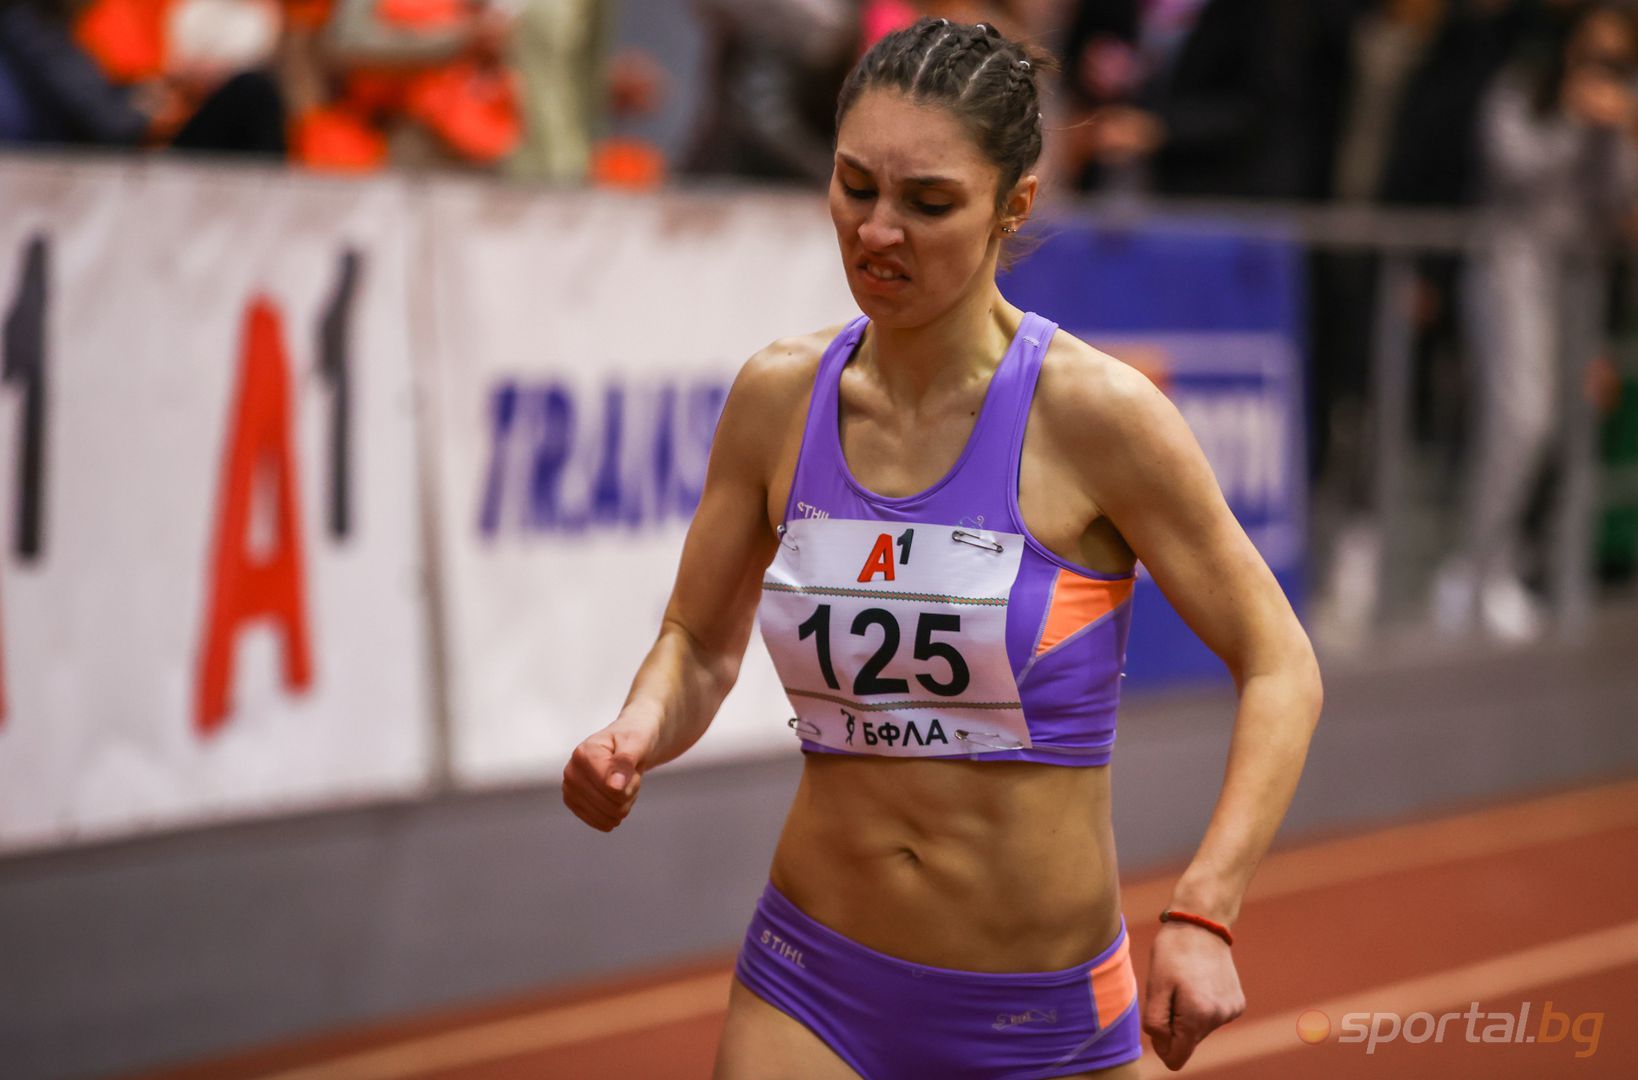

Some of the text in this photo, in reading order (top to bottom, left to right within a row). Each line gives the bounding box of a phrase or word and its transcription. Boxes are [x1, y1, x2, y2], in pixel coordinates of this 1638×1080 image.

[194, 245, 366, 736] A1
[857, 528, 915, 583] A1
[798, 604, 970, 697] 125
[862, 718, 949, 747] БФЛА
[760, 929, 806, 969] STIHL
